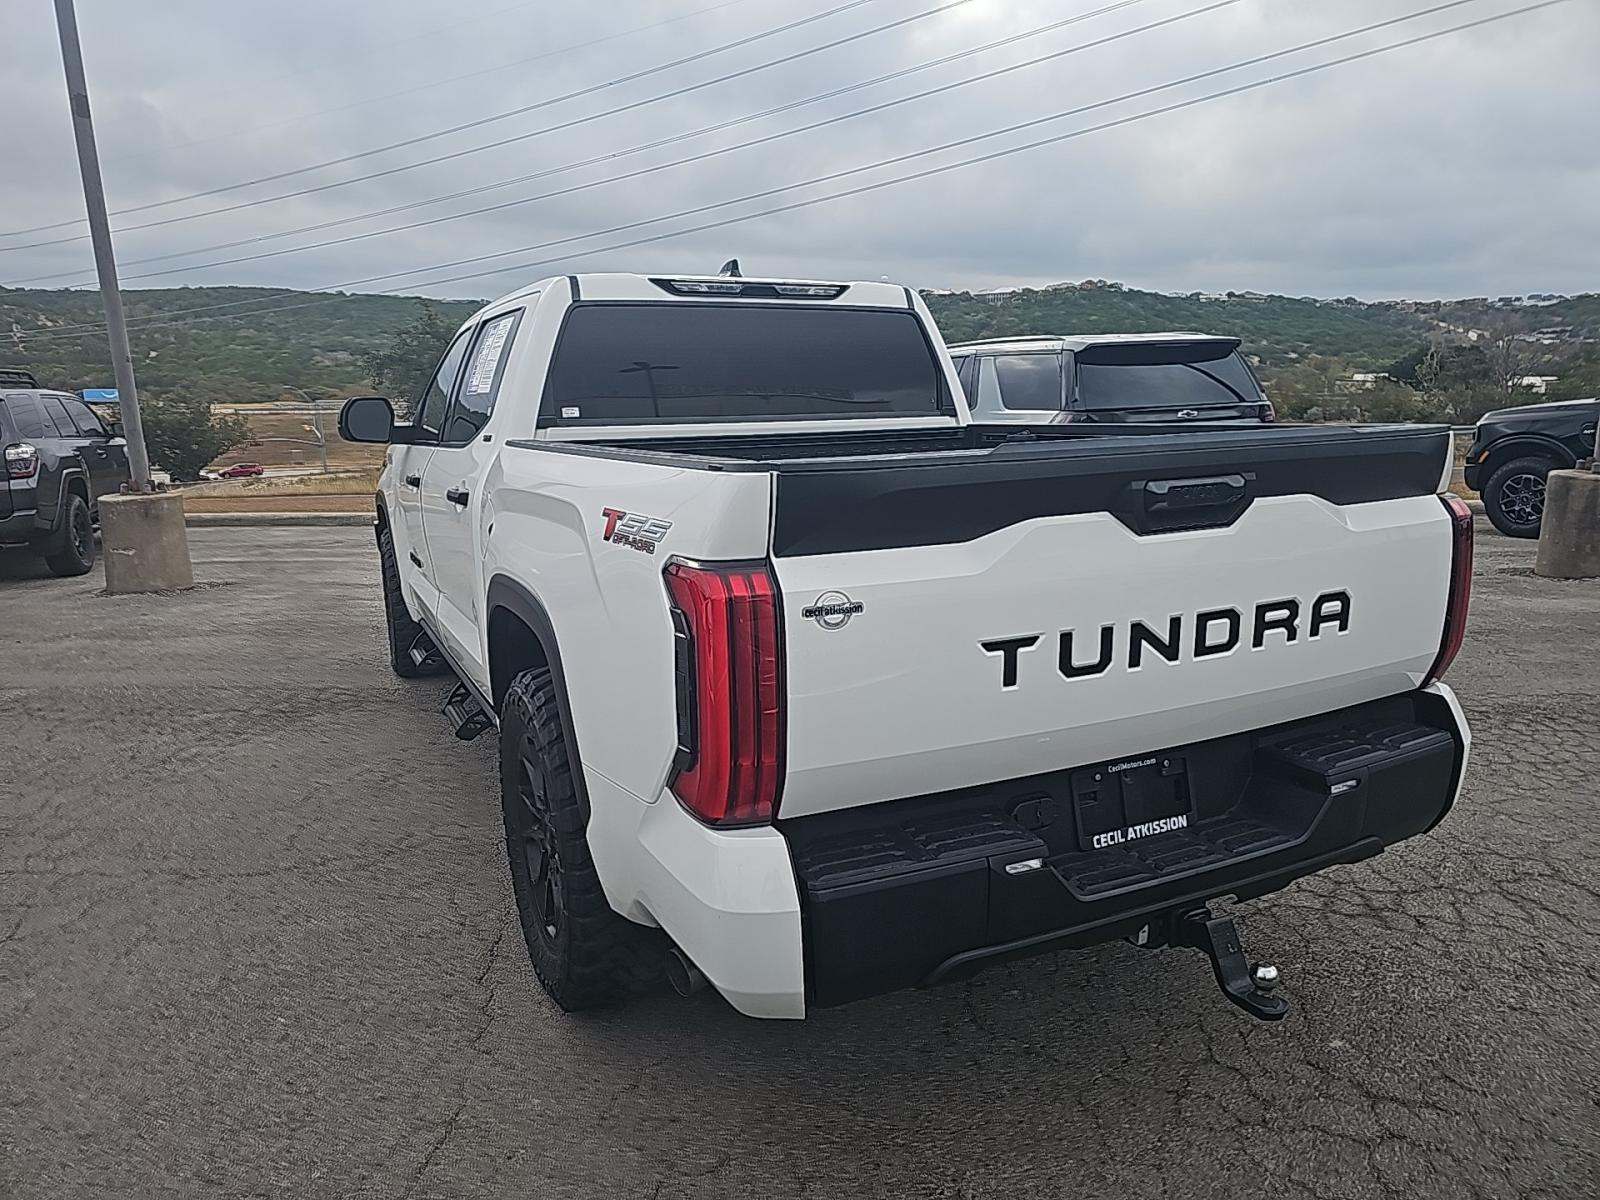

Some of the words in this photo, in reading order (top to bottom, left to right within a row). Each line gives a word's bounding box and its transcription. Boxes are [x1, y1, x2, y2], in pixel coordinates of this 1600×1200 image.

[979, 588, 1351, 690] TUNDRA
[1107, 758, 1157, 773] CecilMotors.com
[1092, 829, 1126, 849] CECIL
[1127, 814, 1188, 841] ATKISSION
